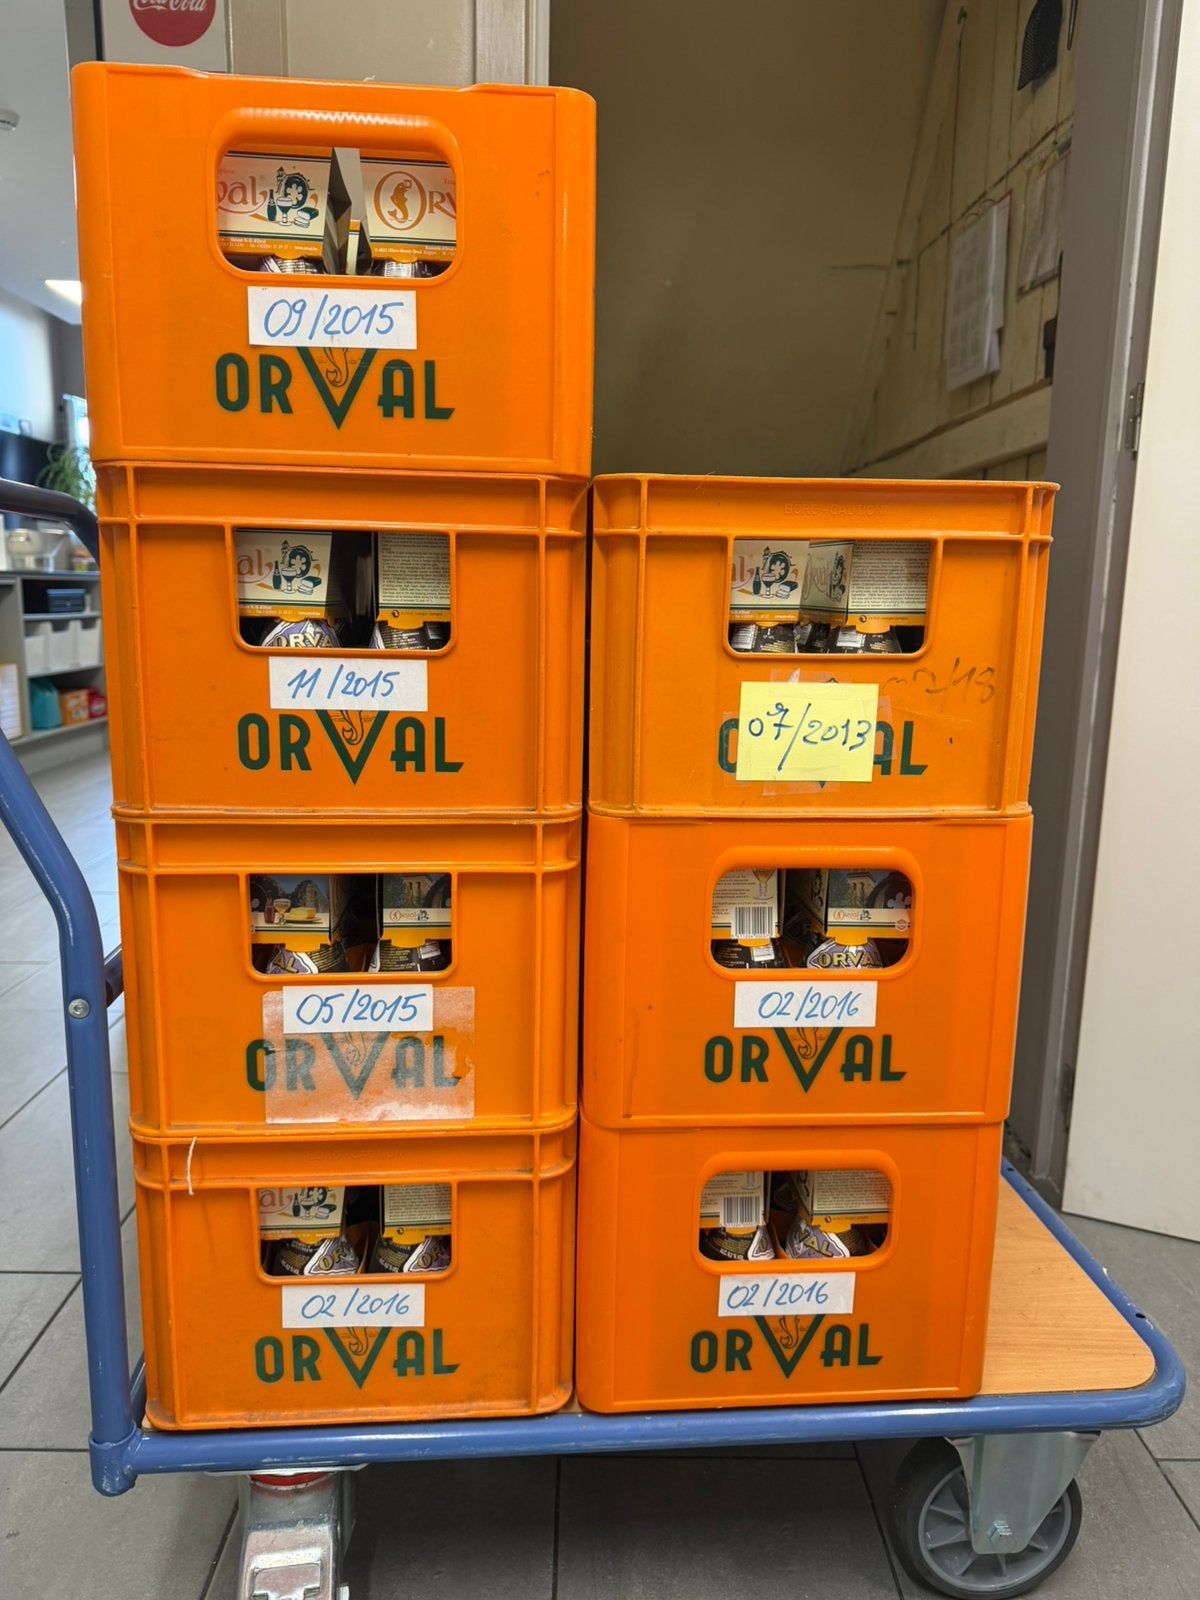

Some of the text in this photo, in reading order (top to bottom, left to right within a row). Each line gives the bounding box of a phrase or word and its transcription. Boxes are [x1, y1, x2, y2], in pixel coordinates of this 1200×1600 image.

[262, 294, 405, 340] 09/2015
[215, 347, 456, 429] ORVAL
[237, 709, 464, 786] ORVAL
[718, 718, 928, 786] OAL
[748, 702, 872, 772] 07/2013
[296, 989, 427, 1026] 05/2015
[757, 986, 863, 1021] 02/2016
[246, 1031, 461, 1101] ORVAL
[704, 1026, 907, 1093] ORVAL
[726, 1278, 829, 1310] 02/2016
[255, 1326, 460, 1390] ORVAL
[690, 1315, 884, 1379] ORVAL
